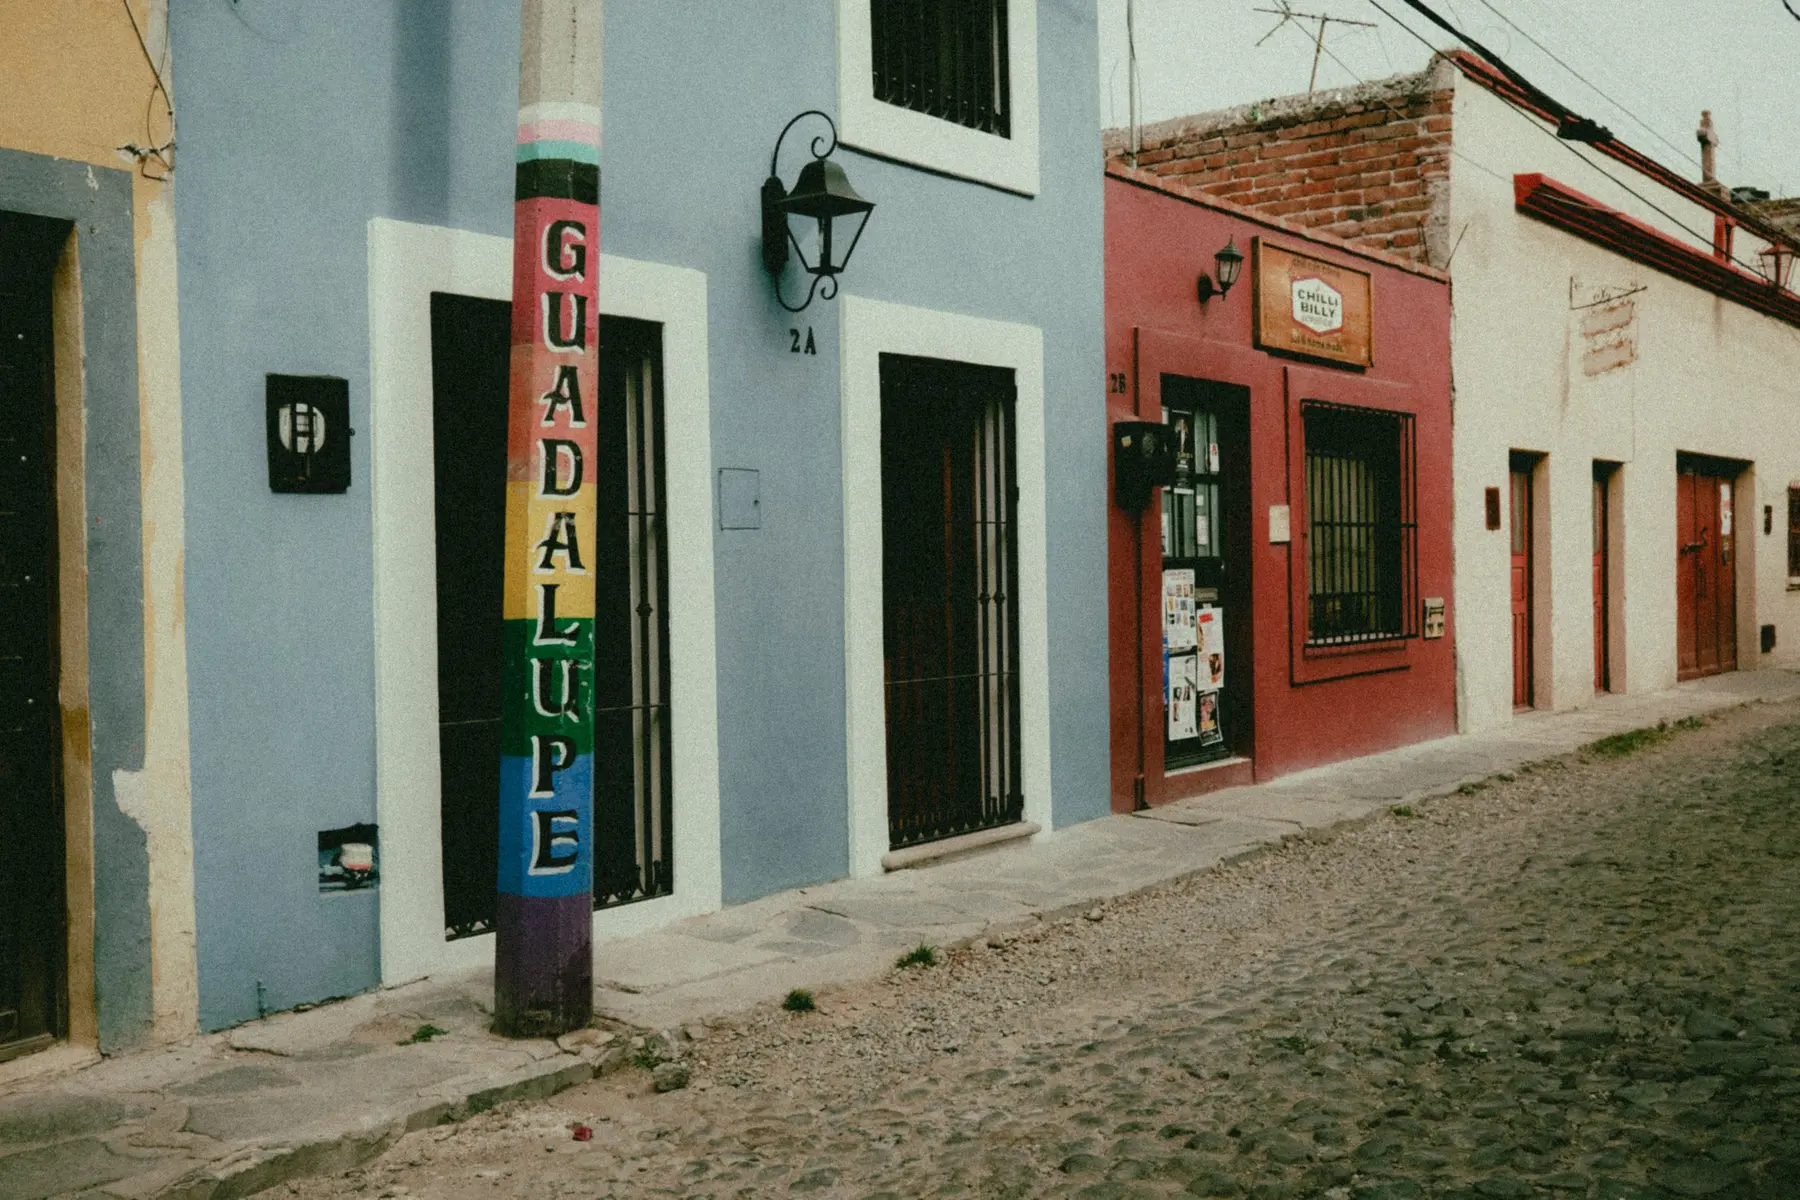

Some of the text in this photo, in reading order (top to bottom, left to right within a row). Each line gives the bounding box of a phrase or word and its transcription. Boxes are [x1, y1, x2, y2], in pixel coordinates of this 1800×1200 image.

[1298, 289, 1339, 307] CHILLI
[1301, 301, 1335, 318] BILLY
[1111, 373, 1126, 394] 2B
[528, 220, 587, 876] GUADALUPE
